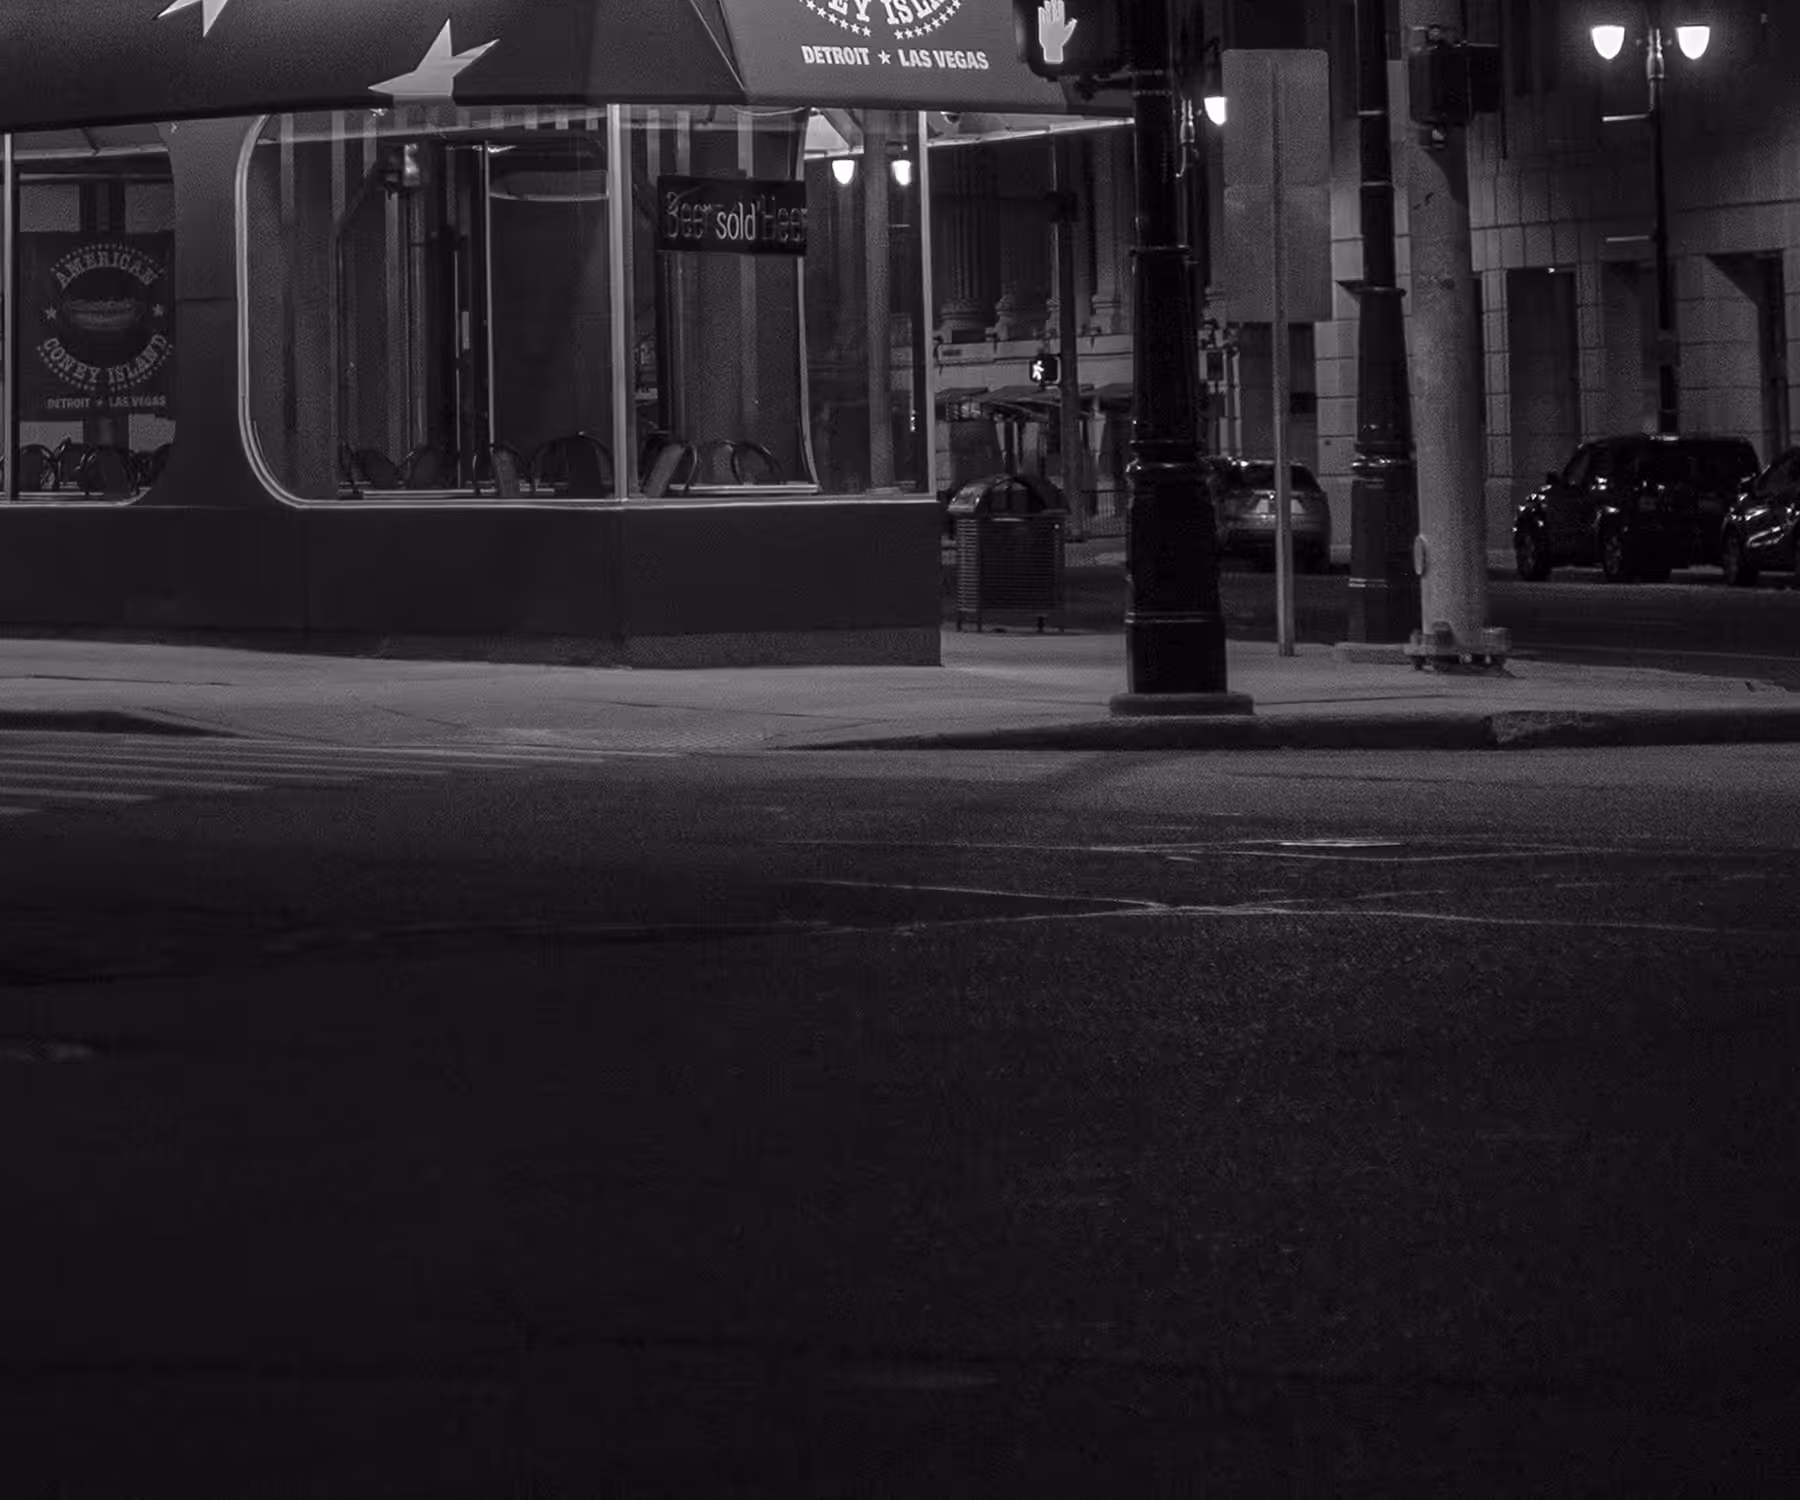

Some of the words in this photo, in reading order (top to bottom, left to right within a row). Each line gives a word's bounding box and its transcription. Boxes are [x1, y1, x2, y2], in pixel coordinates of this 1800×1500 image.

[800, 45, 871, 65] DETROIT
[897, 49, 932, 68] LAS
[932, 49, 990, 70] VEGAS
[715, 201, 757, 240] sold
[56, 251, 159, 291] AMERICAN
[43, 338, 100, 383] CONEY
[106, 333, 167, 385] ISLAND
[48, 397, 91, 408] DETROIT
[109, 397, 129, 407] LAS
[130, 395, 166, 407] VEGAS
